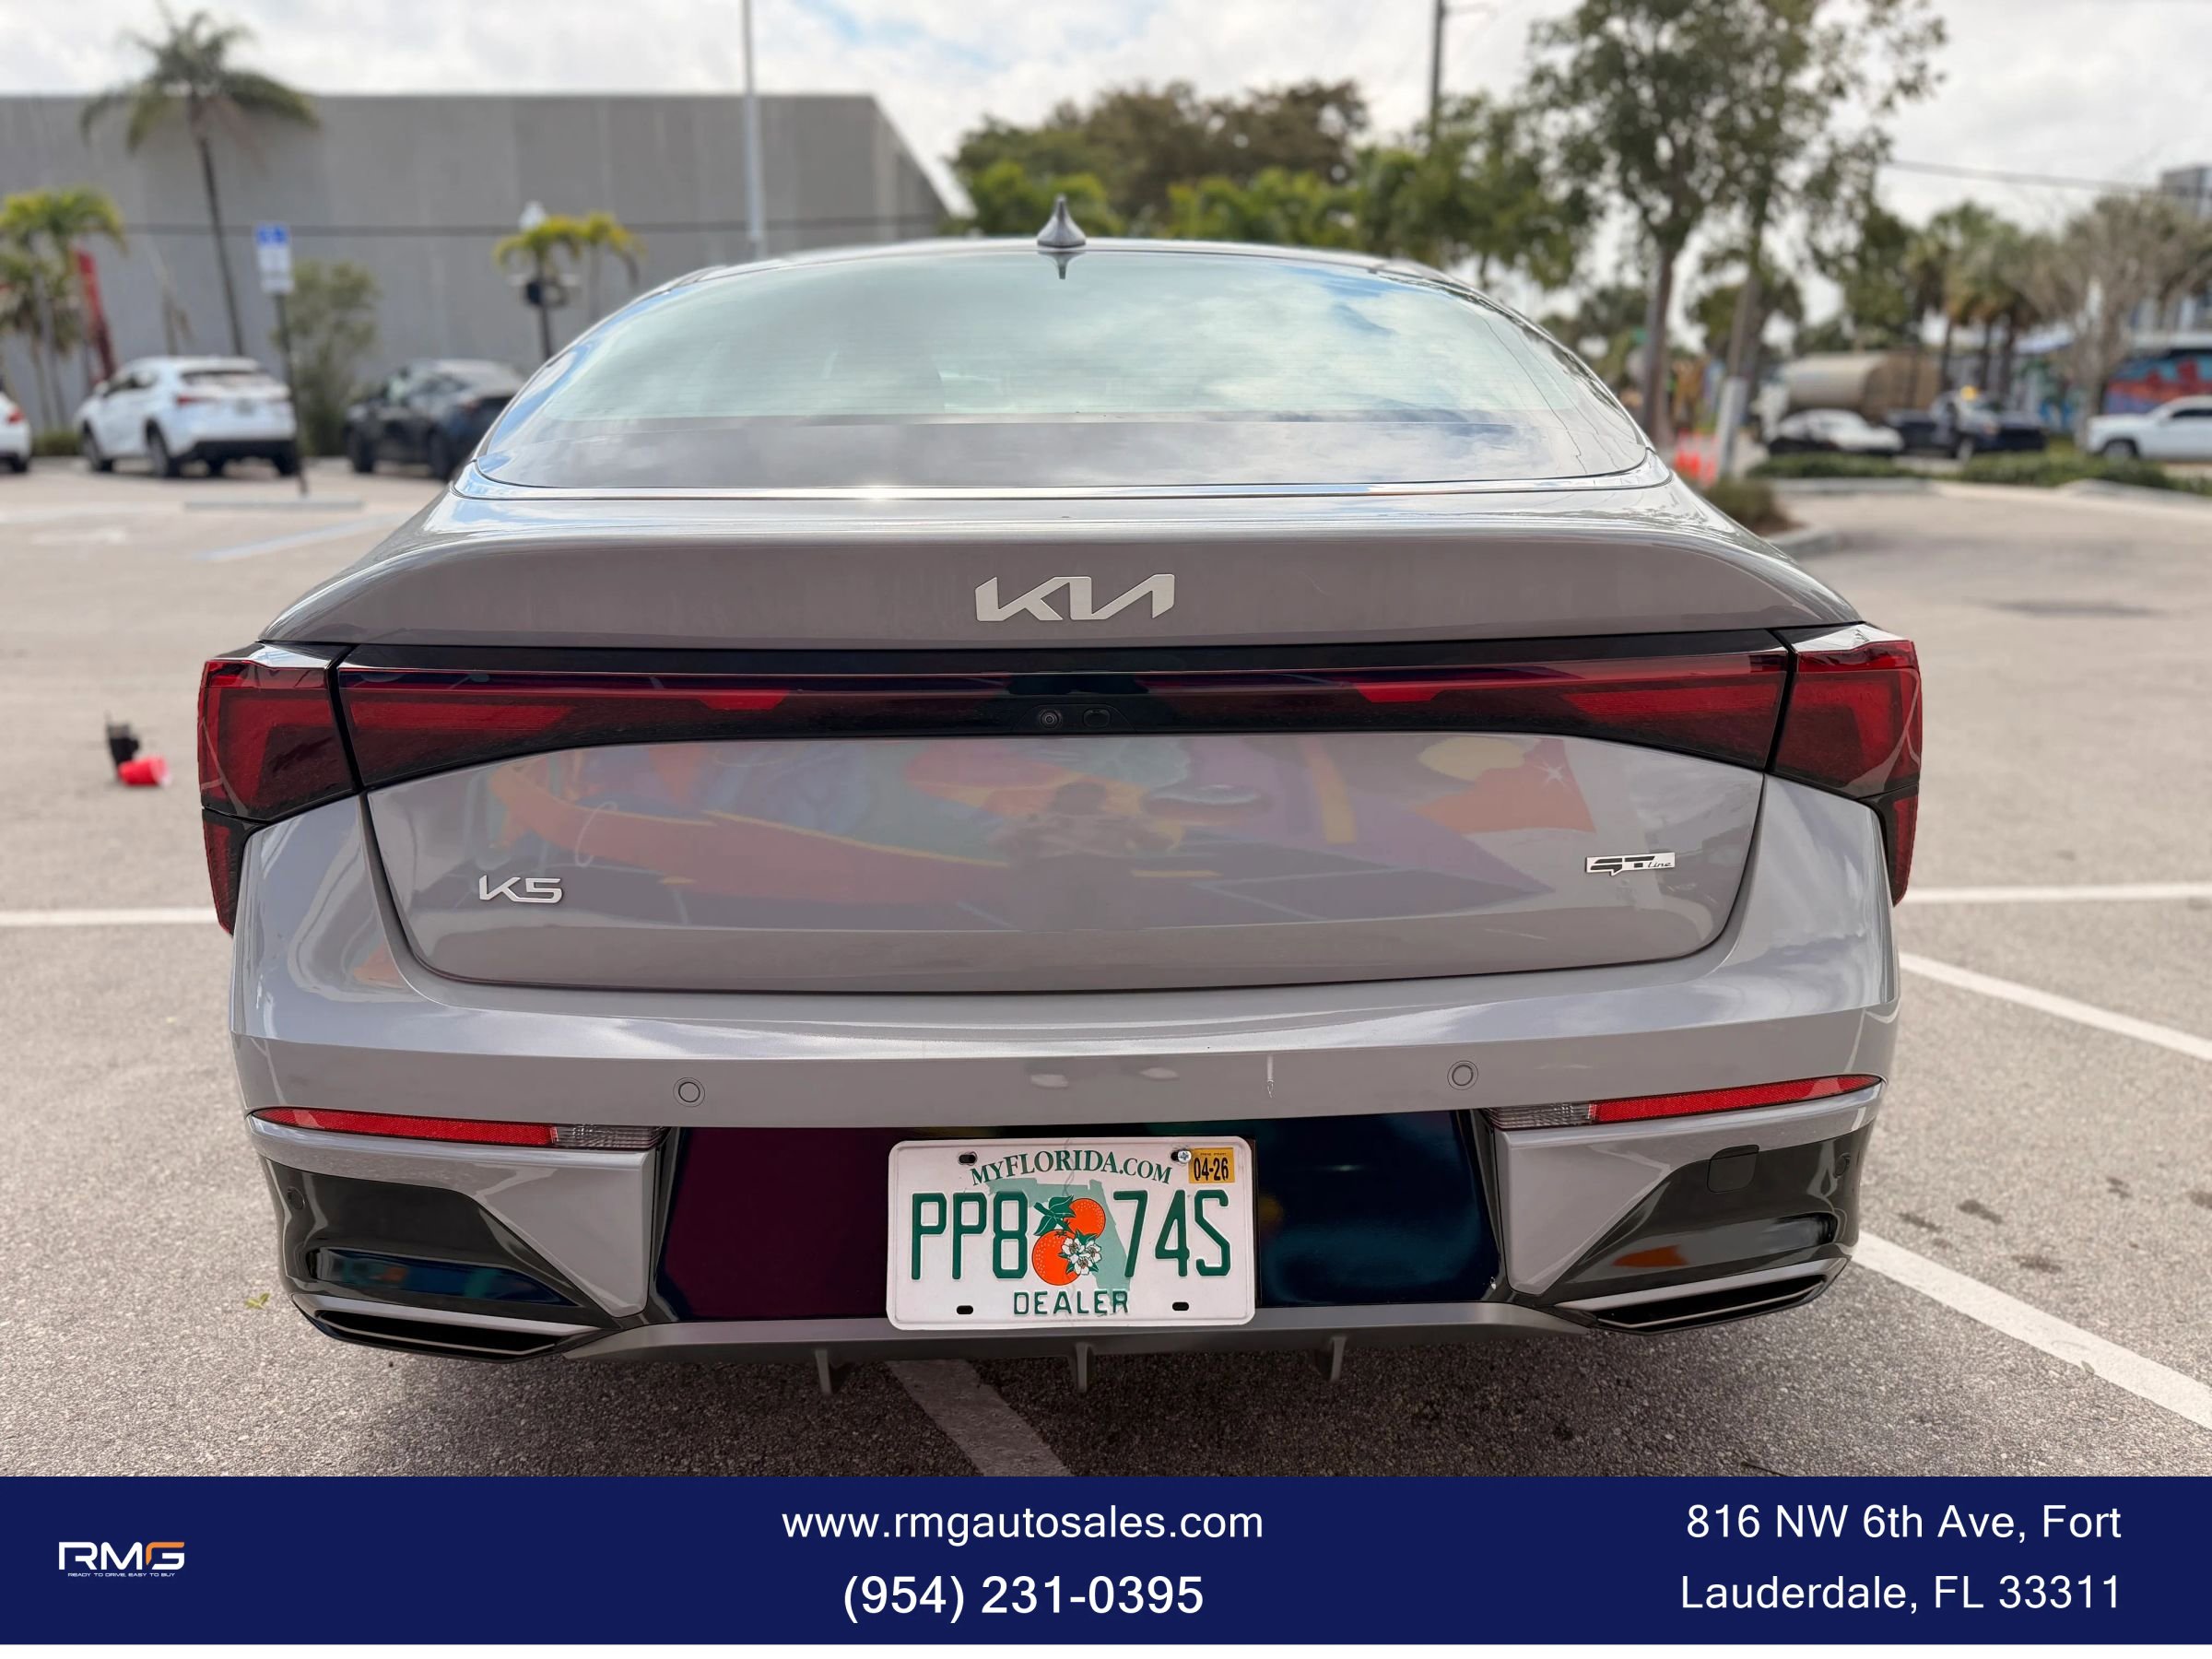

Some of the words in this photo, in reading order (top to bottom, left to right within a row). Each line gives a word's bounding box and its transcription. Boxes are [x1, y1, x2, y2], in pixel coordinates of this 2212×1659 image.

[975, 573, 1174, 621] KIA
[478, 875, 563, 904] K5
[970, 1148, 1173, 1186] MYFLORIDA.COM
[1194, 1157, 1229, 1181] 04-26
[911, 1191, 1029, 1280] PP8
[1112, 1189, 1231, 1277] 74S
[1013, 1289, 1129, 1315] DEALER
